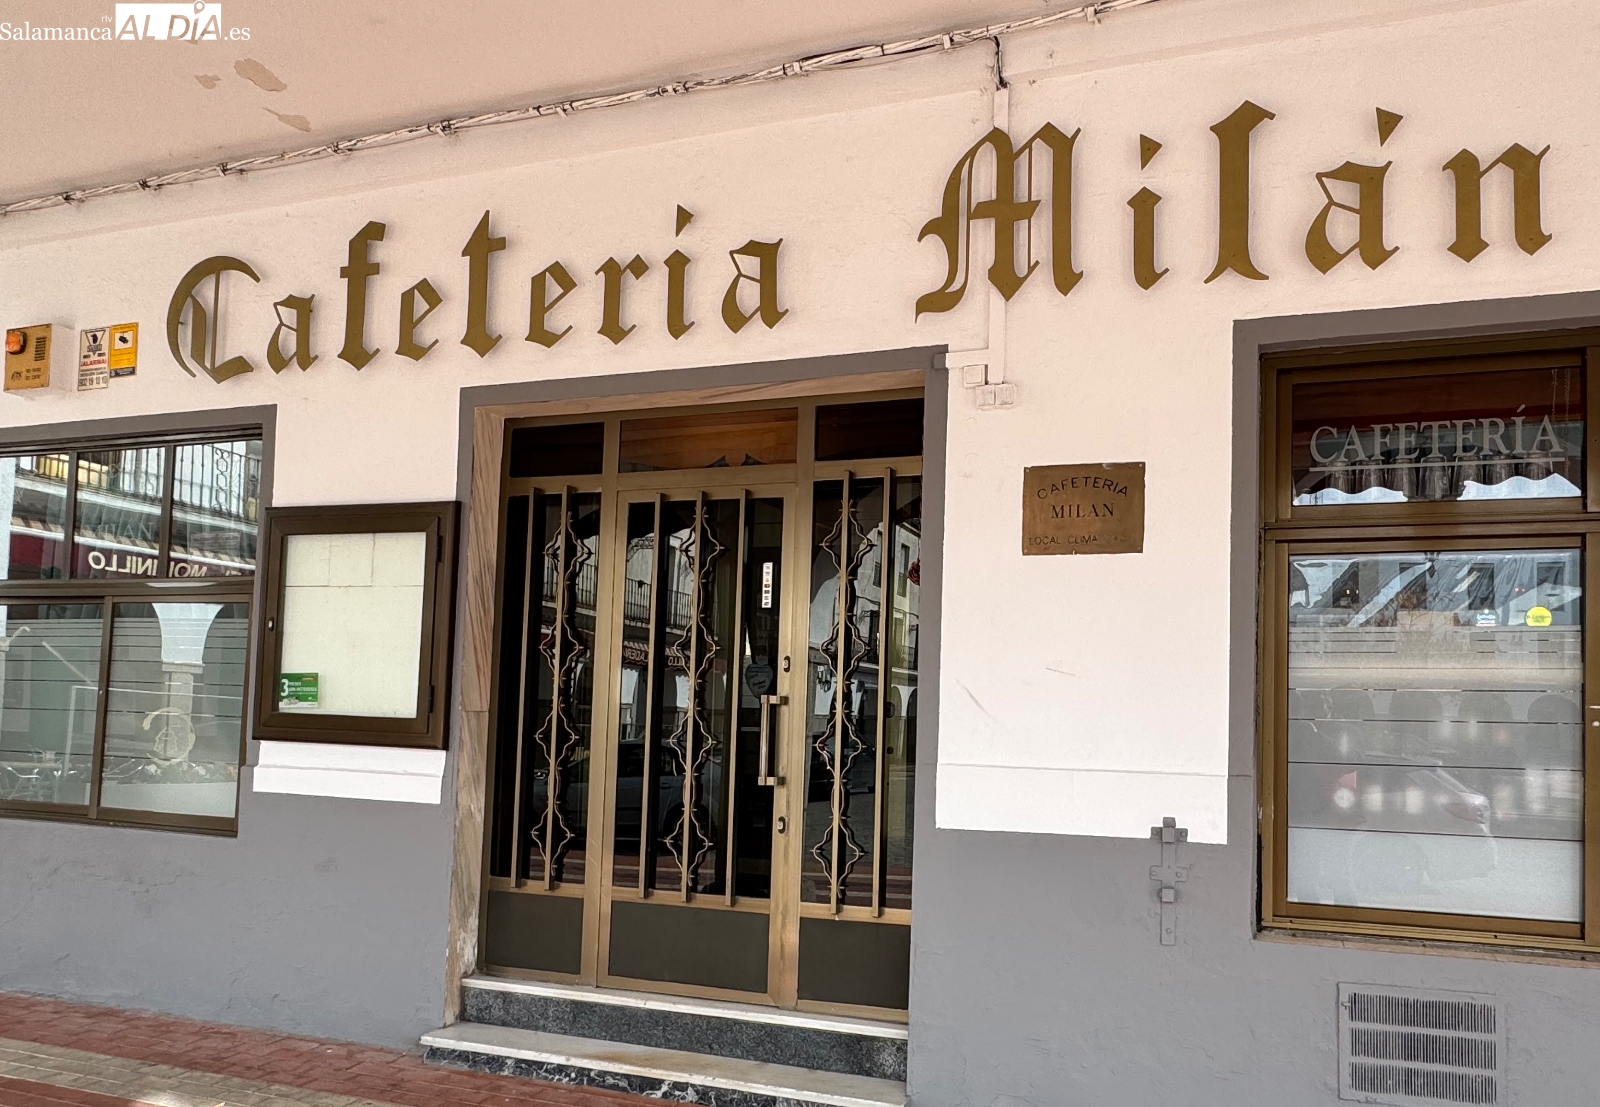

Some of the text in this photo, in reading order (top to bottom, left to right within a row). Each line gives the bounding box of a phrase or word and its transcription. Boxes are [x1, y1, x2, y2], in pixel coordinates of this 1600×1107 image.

[915, 99, 1553, 324] Milán
[1309, 403, 1564, 464] CAFETERÍA
[1037, 476, 1128, 499] CAFETERIA
[1051, 503, 1114, 519] MILAN
[1028, 535, 1061, 546] LOCAL
